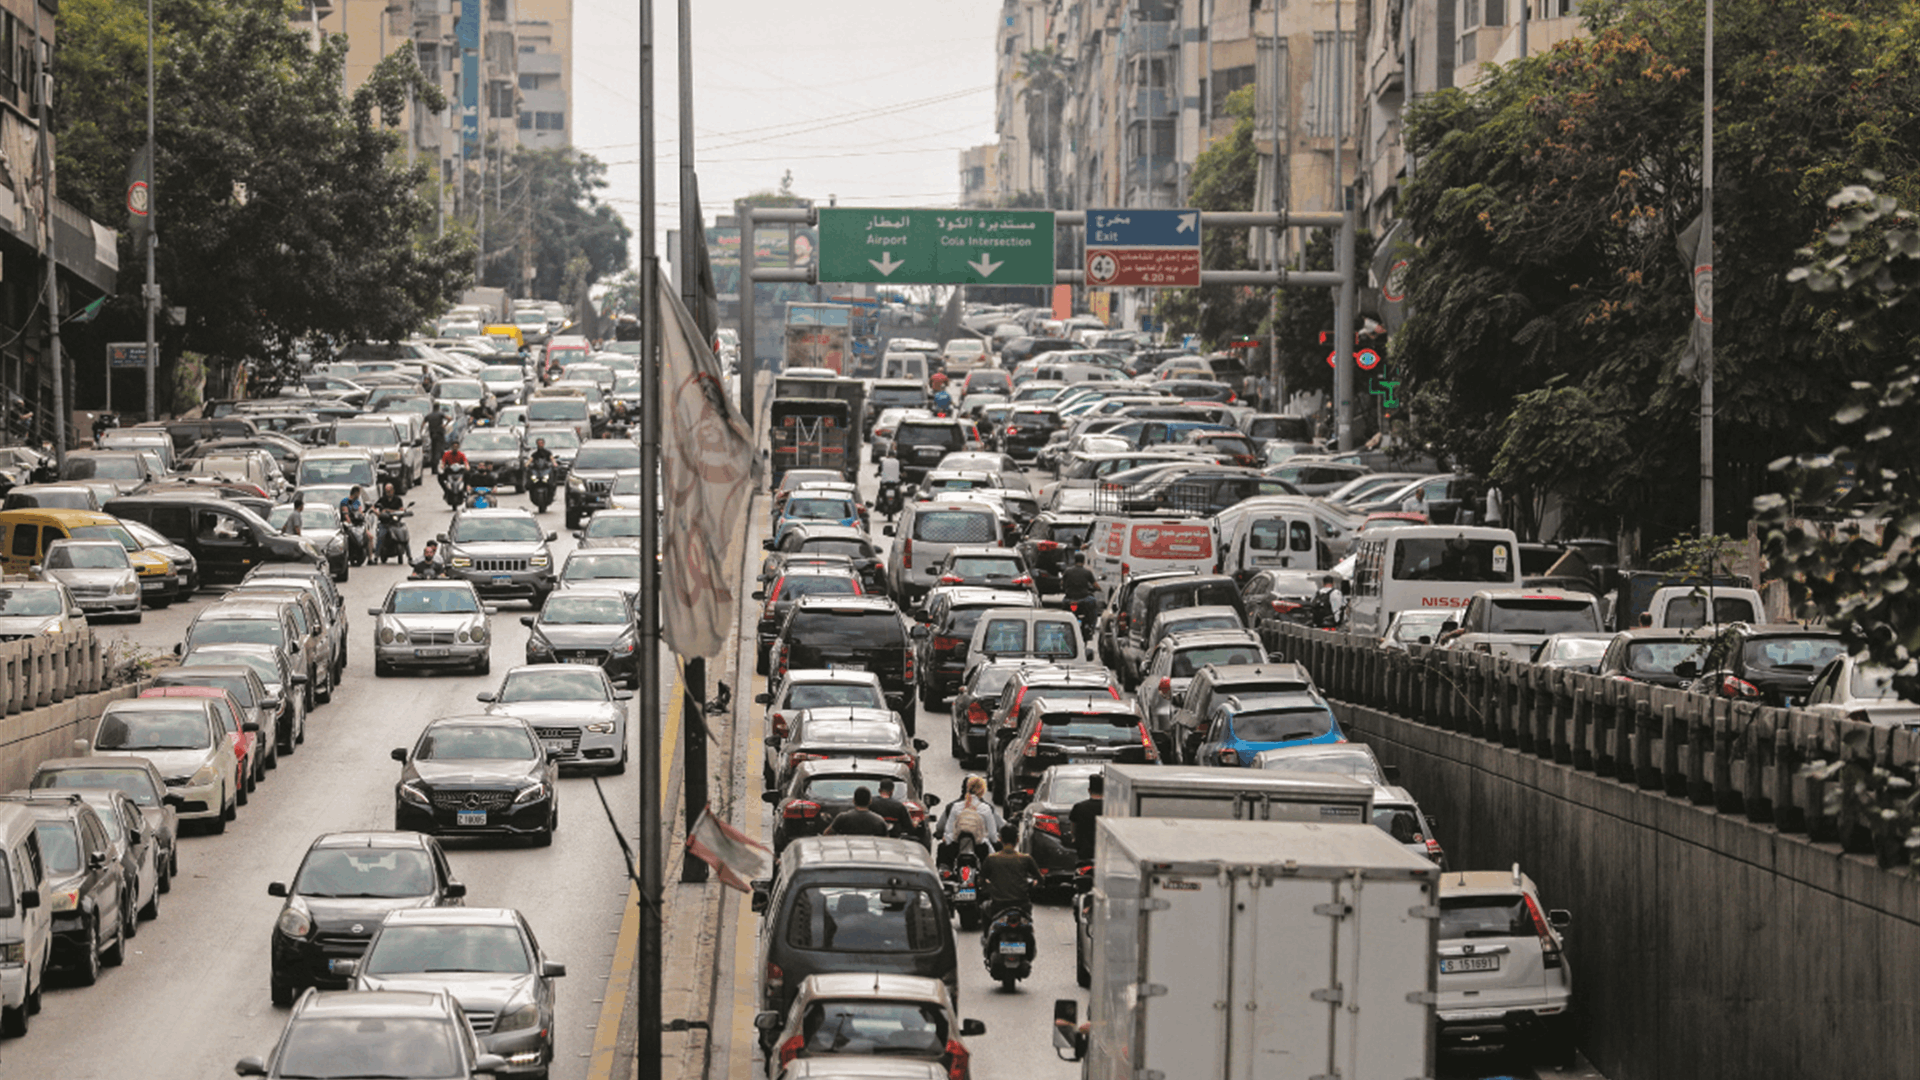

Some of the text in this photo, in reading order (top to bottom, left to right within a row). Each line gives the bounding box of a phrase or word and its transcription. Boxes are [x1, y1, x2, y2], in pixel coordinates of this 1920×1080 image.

[865, 216, 910, 231] المطار
[936, 216, 1036, 232] مستديرة الكولا
[1095, 213, 1131, 228] مخرج
[866, 235, 908, 246] Airport
[968, 236, 1032, 247] Intersection
[1095, 230, 1119, 242] Exit
[1141, 272, 1176, 282] 4.20 m
[1421, 597, 1471, 607] NISSA
[1447, 960, 1454, 970] S
